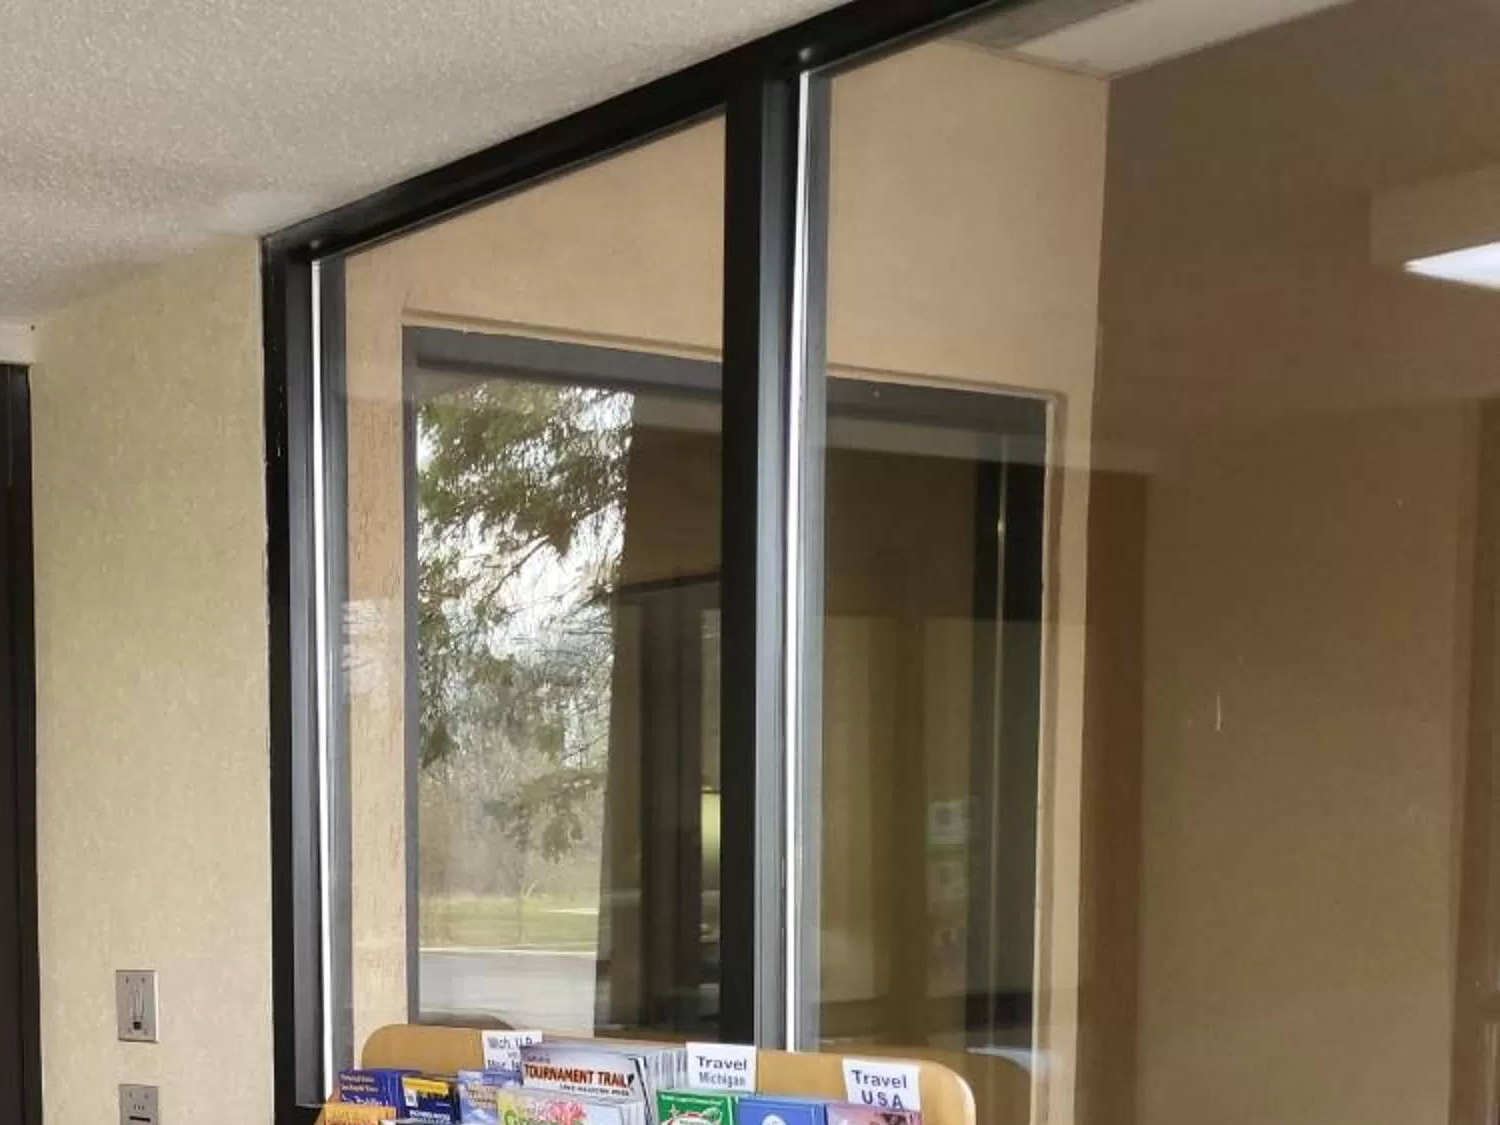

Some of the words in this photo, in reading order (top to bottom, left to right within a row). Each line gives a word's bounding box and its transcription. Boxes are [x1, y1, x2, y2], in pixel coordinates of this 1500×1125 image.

[696, 1055, 748, 1071] Travel
[523, 1063, 593, 1085] TOURNAMENT
[597, 1070, 629, 1089] TRAIL
[699, 1070, 746, 1088] Michigan
[851, 1068, 908, 1090] Travel
